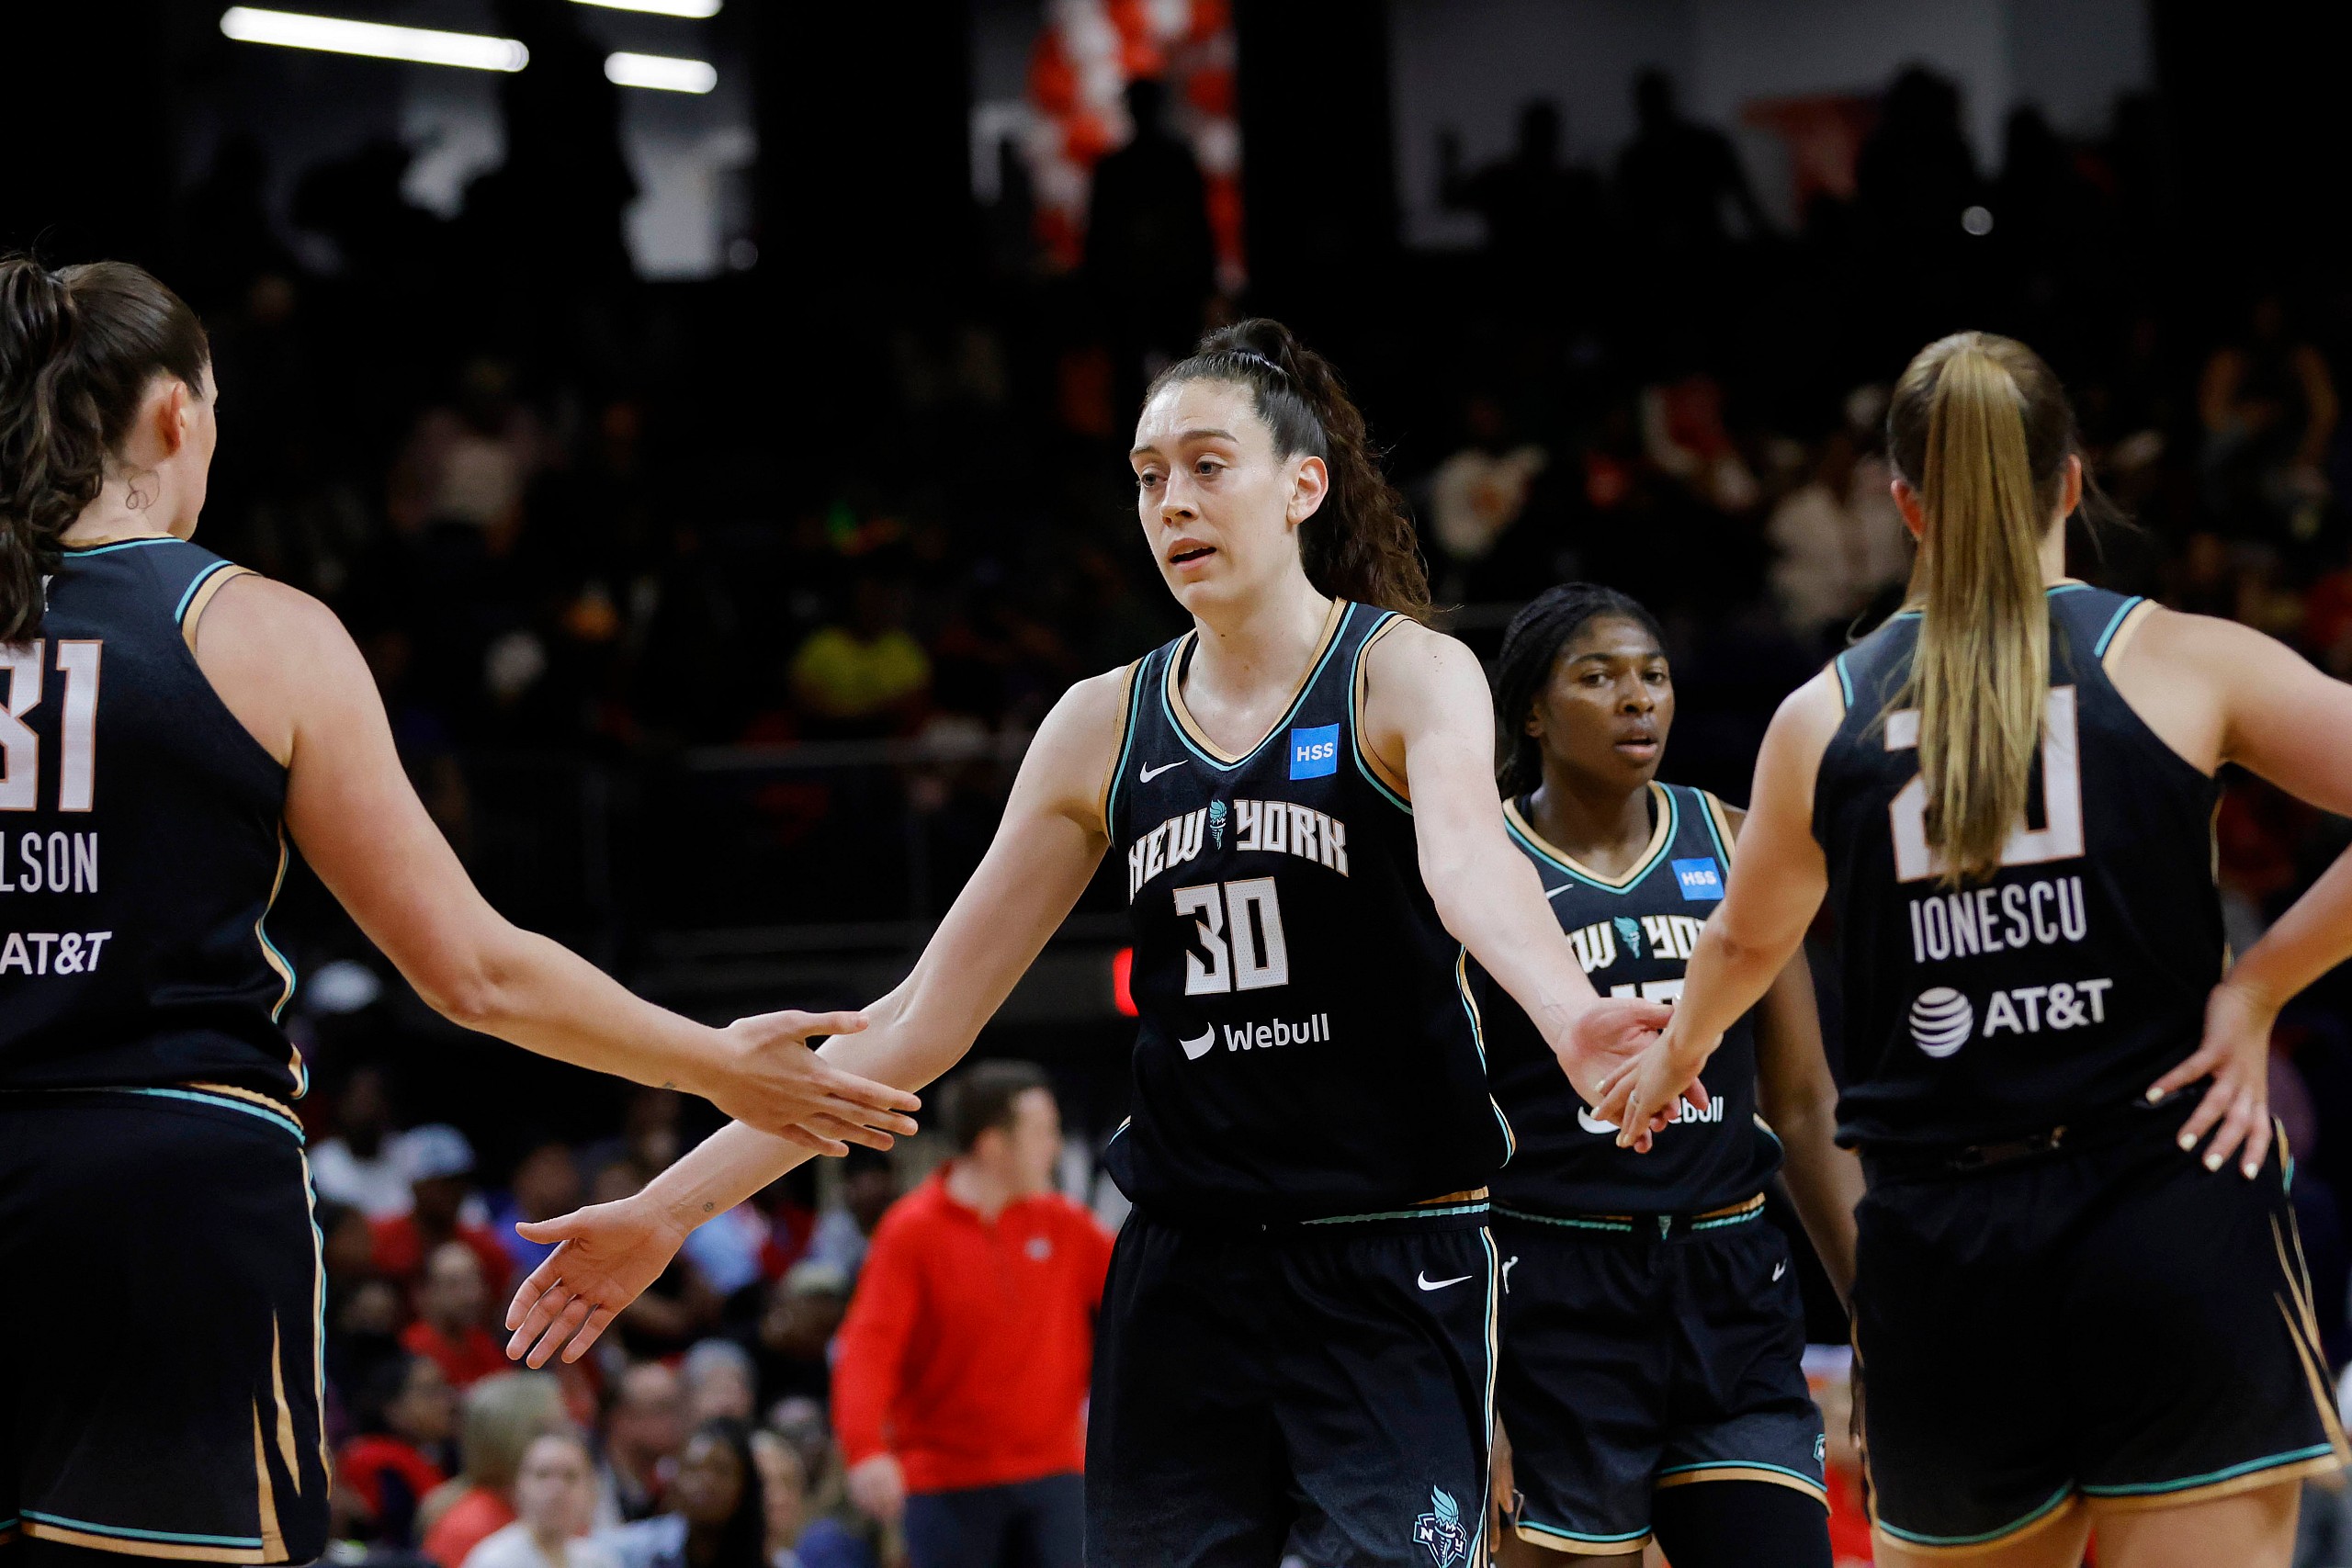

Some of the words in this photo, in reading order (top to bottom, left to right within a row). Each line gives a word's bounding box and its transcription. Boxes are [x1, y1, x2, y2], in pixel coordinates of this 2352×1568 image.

[0, 638, 103, 812] 31
[1296, 741, 1333, 761] HSS
[1128, 806, 1207, 906] NEW
[1234, 798, 1349, 877] YORK
[1681, 871, 1717, 886] HSS
[1173, 876, 1289, 996] 30
[1910, 876, 2086, 963] IONESCU
[0, 930, 112, 975] AT&T
[1223, 1013, 1330, 1052] Webull
[1983, 978, 2113, 1037] AT&T
